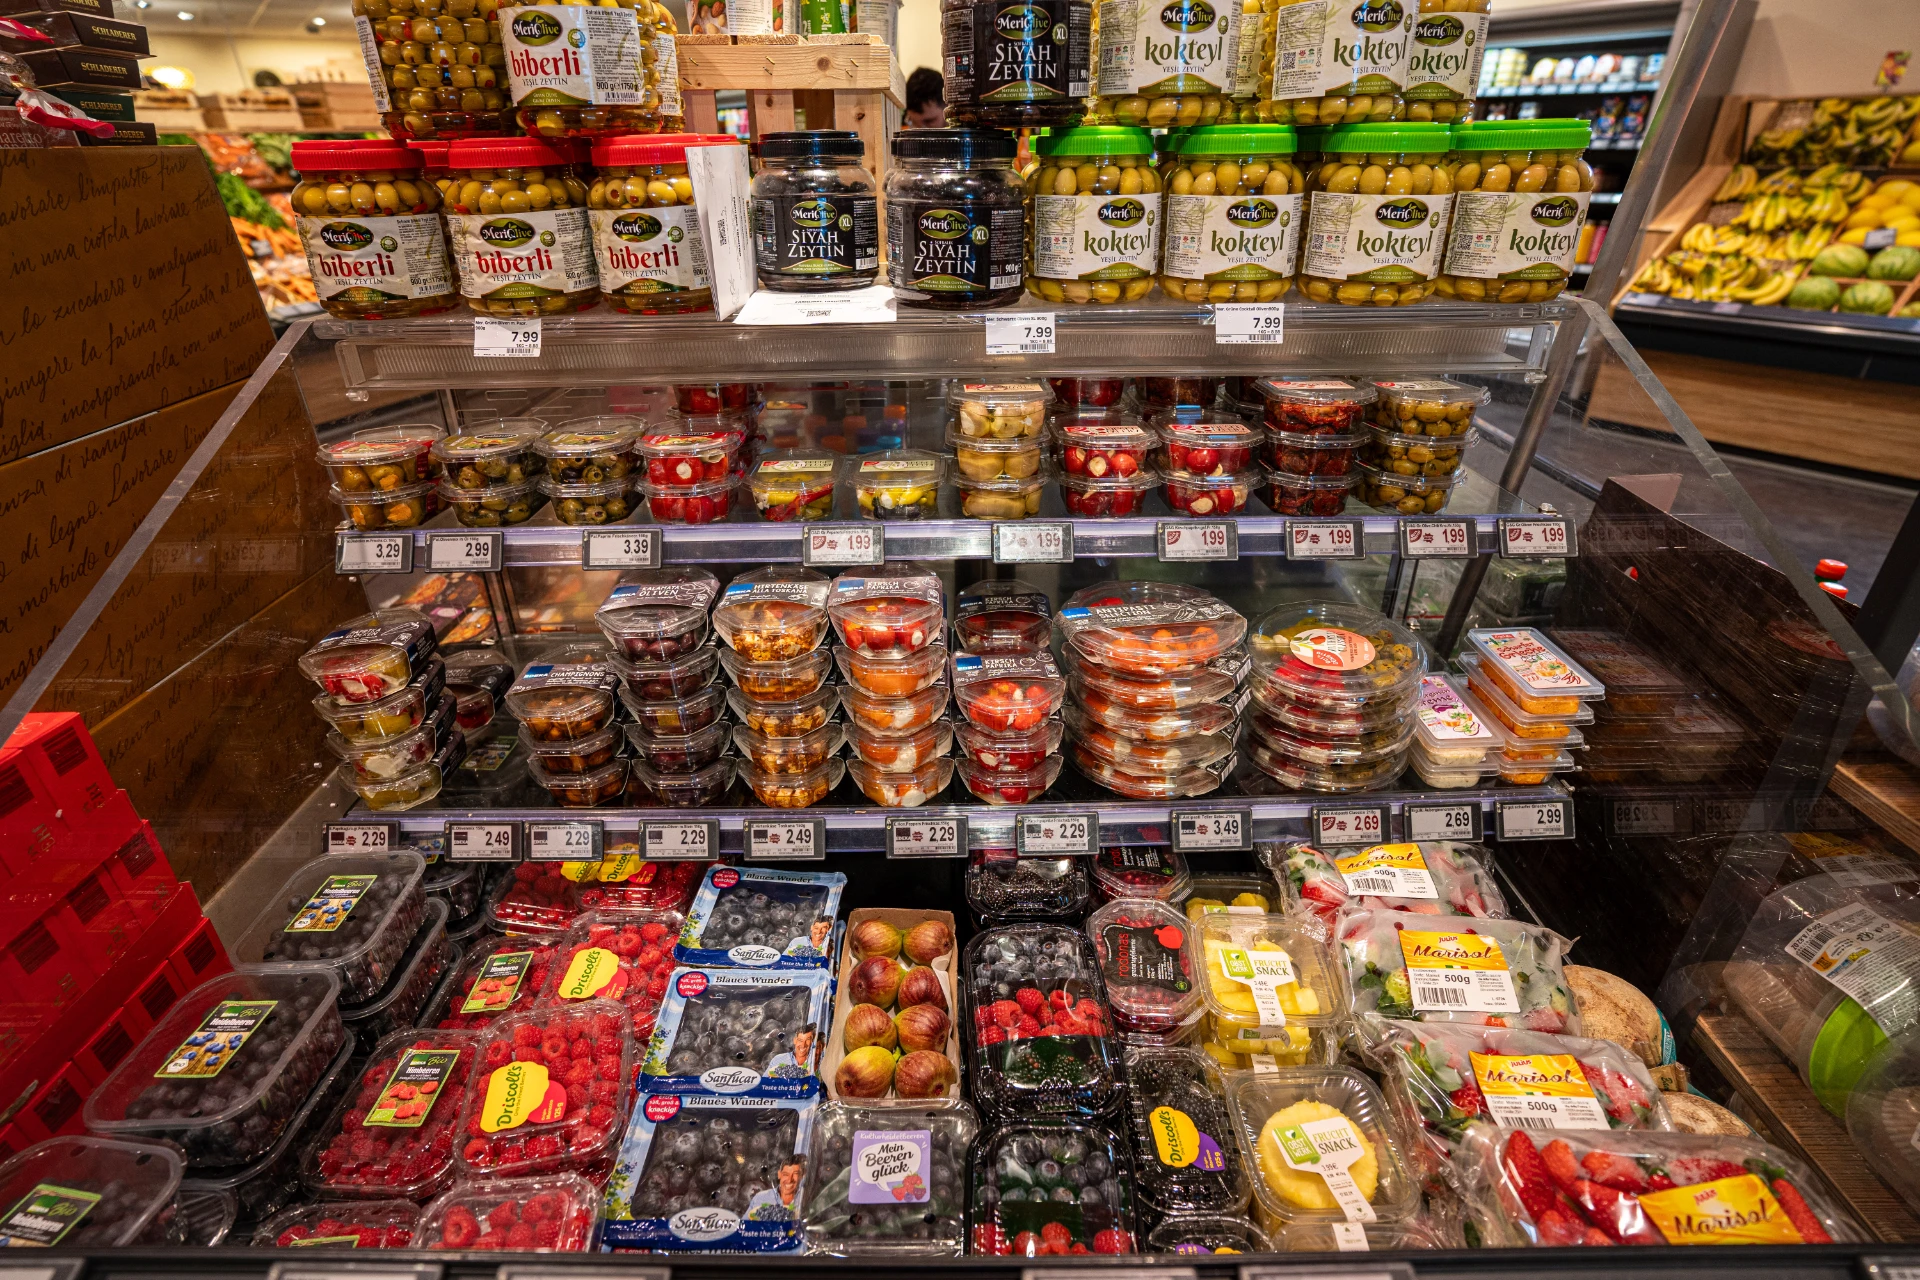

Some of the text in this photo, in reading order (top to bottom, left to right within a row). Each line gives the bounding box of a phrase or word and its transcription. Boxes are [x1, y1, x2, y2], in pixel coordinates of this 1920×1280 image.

[92, 26, 136, 40] SCHLADERER
[1056, 28, 1065, 40] XL
[995, 43, 1051, 62] SİYAH
[1145, 36, 1223, 67] kokteyl
[1333, 34, 1408, 67] kokteyl
[81, 62, 128, 75] SCHLADERER
[510, 49, 581, 77] biberli
[988, 61, 1057, 81] ZEYTİN
[80, 101, 123, 110] SCHLADERER
[842, 218, 850, 226] XL
[792, 230, 838, 244] SİYAH
[976, 230, 986, 240] XL
[1084, 228, 1151, 256] kokteyl
[1211, 229, 1284, 257] kokteyl
[1510, 228, 1579, 256] kokteyl
[788, 242, 844, 257] ZEYTİN
[920, 240, 970, 258] SİYAH
[1357, 230, 1433, 258] kokteyl
[318, 253, 394, 277] biberli
[474, 248, 553, 274] biberli
[608, 244, 679, 269] biberli
[914, 256, 976, 274] ZEYTİN
[1253, 318, 1280, 328] 7.99
[512, 332, 538, 342] 7.99
[1024, 327, 1052, 338] 7.99
[732, 948, 778, 962] SanLucar
[1115, 932, 1130, 978] rodonas
[1414, 945, 1492, 958] Marisol
[570, 951, 600, 995] Driscoll's
[1256, 967, 1290, 976] SNACK
[1444, 975, 1470, 984] 500g
[406, 1066, 441, 1074] Himbeeren
[704, 1070, 758, 1087] SanLucar
[1486, 1069, 1573, 1084] Marisol
[496, 1065, 522, 1128] Driscoll's
[730, 1098, 776, 1106] Wunder
[648, 1106, 677, 1114] knackig!
[1528, 1101, 1557, 1113] 500g
[1159, 1110, 1183, 1163] Driscoll's
[1312, 1128, 1350, 1142] FRUCHT
[878, 1144, 905, 1154] Mein
[1318, 1138, 1357, 1155] SNACK
[865, 1150, 914, 1167] Beeren
[872, 1161, 910, 1181] glück
[675, 1213, 736, 1235] SanLucar
[1673, 1198, 1772, 1237] Marisol
